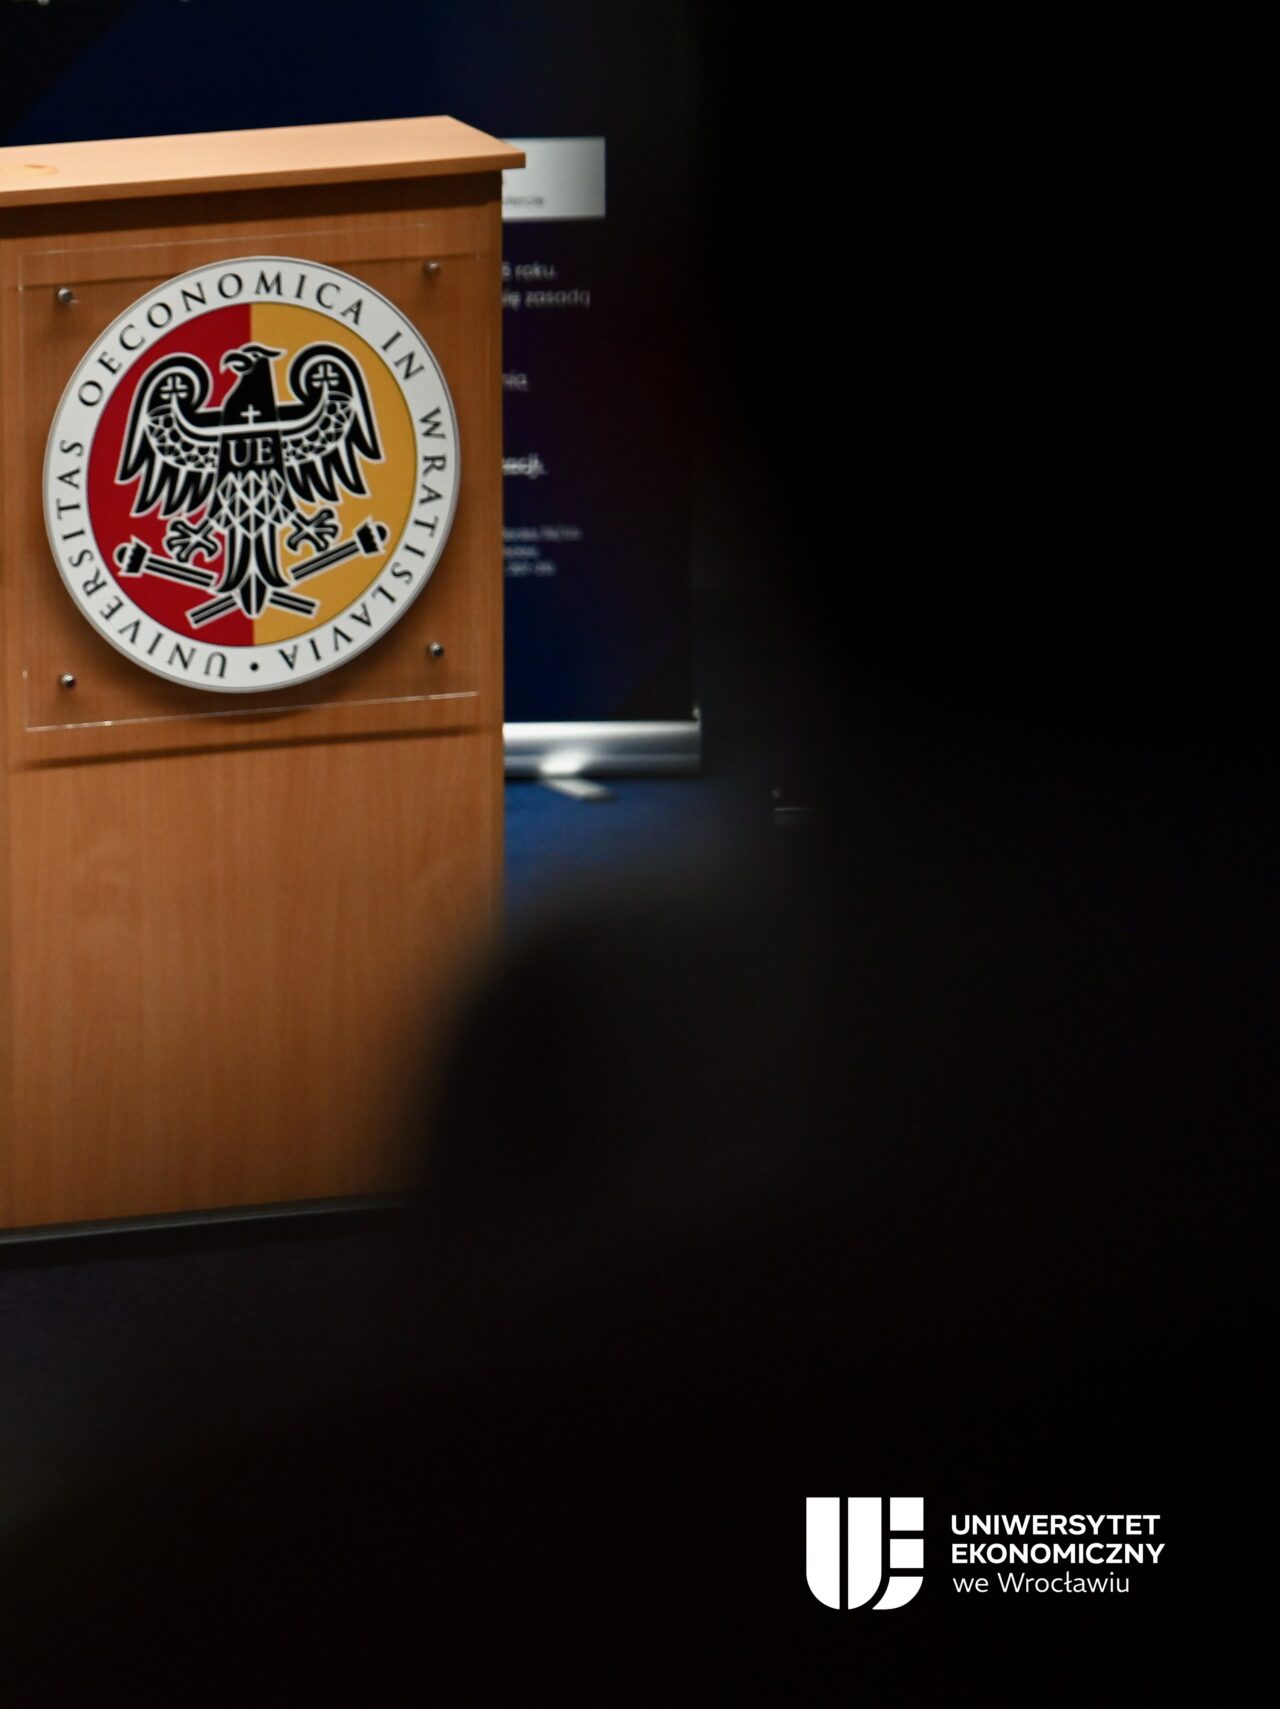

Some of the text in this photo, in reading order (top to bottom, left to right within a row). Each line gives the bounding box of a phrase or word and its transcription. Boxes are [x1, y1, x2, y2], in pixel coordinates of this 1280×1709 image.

[57, 270, 448, 679] UNIVERSITAS OECONOMICA IN WRATISLAVIA
[227, 437, 276, 467] UE
